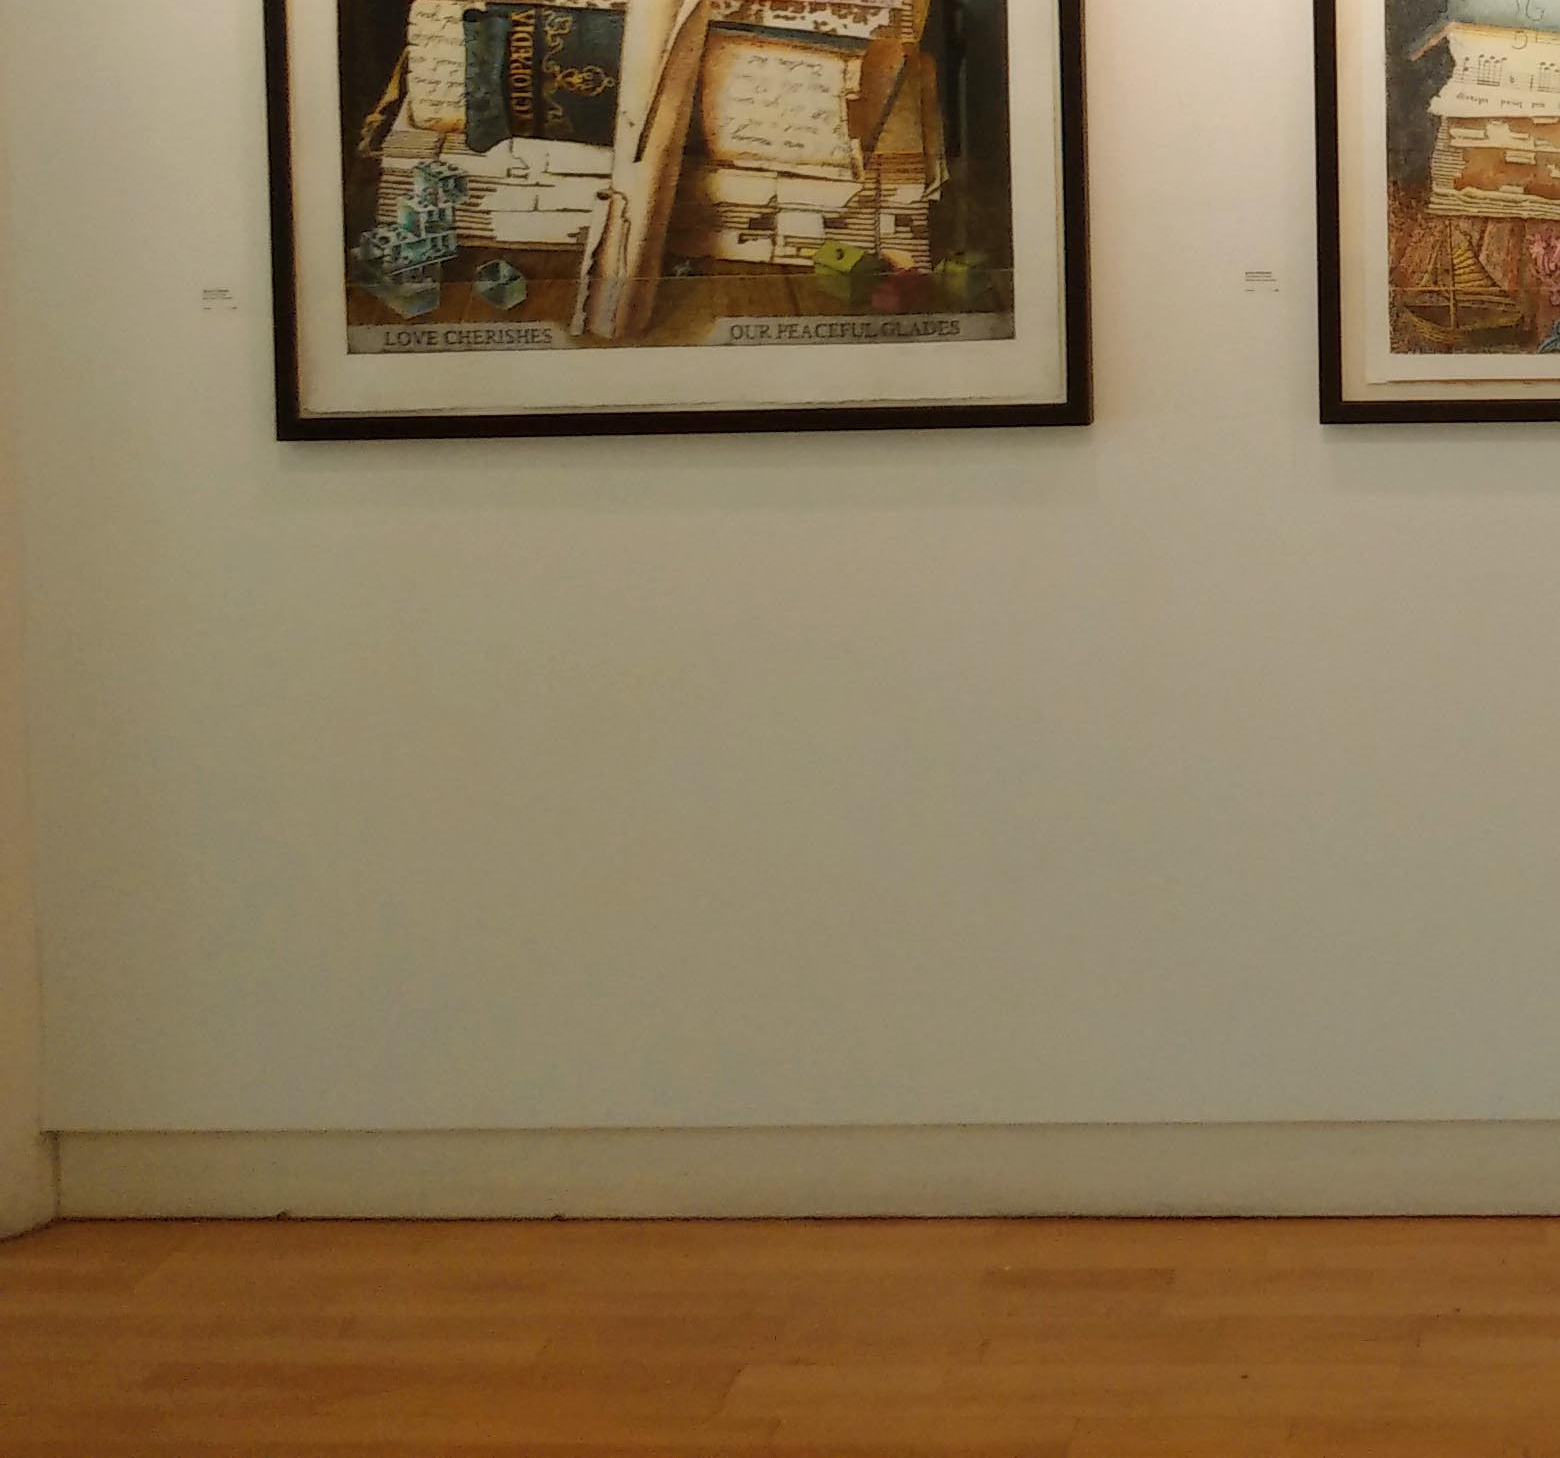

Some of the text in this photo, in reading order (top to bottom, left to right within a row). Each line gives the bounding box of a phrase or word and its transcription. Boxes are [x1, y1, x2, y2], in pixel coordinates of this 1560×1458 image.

[384, 326, 554, 348] LOVE CHERISHES
[729, 320, 962, 341] OUR PEACEFUL GLADES
